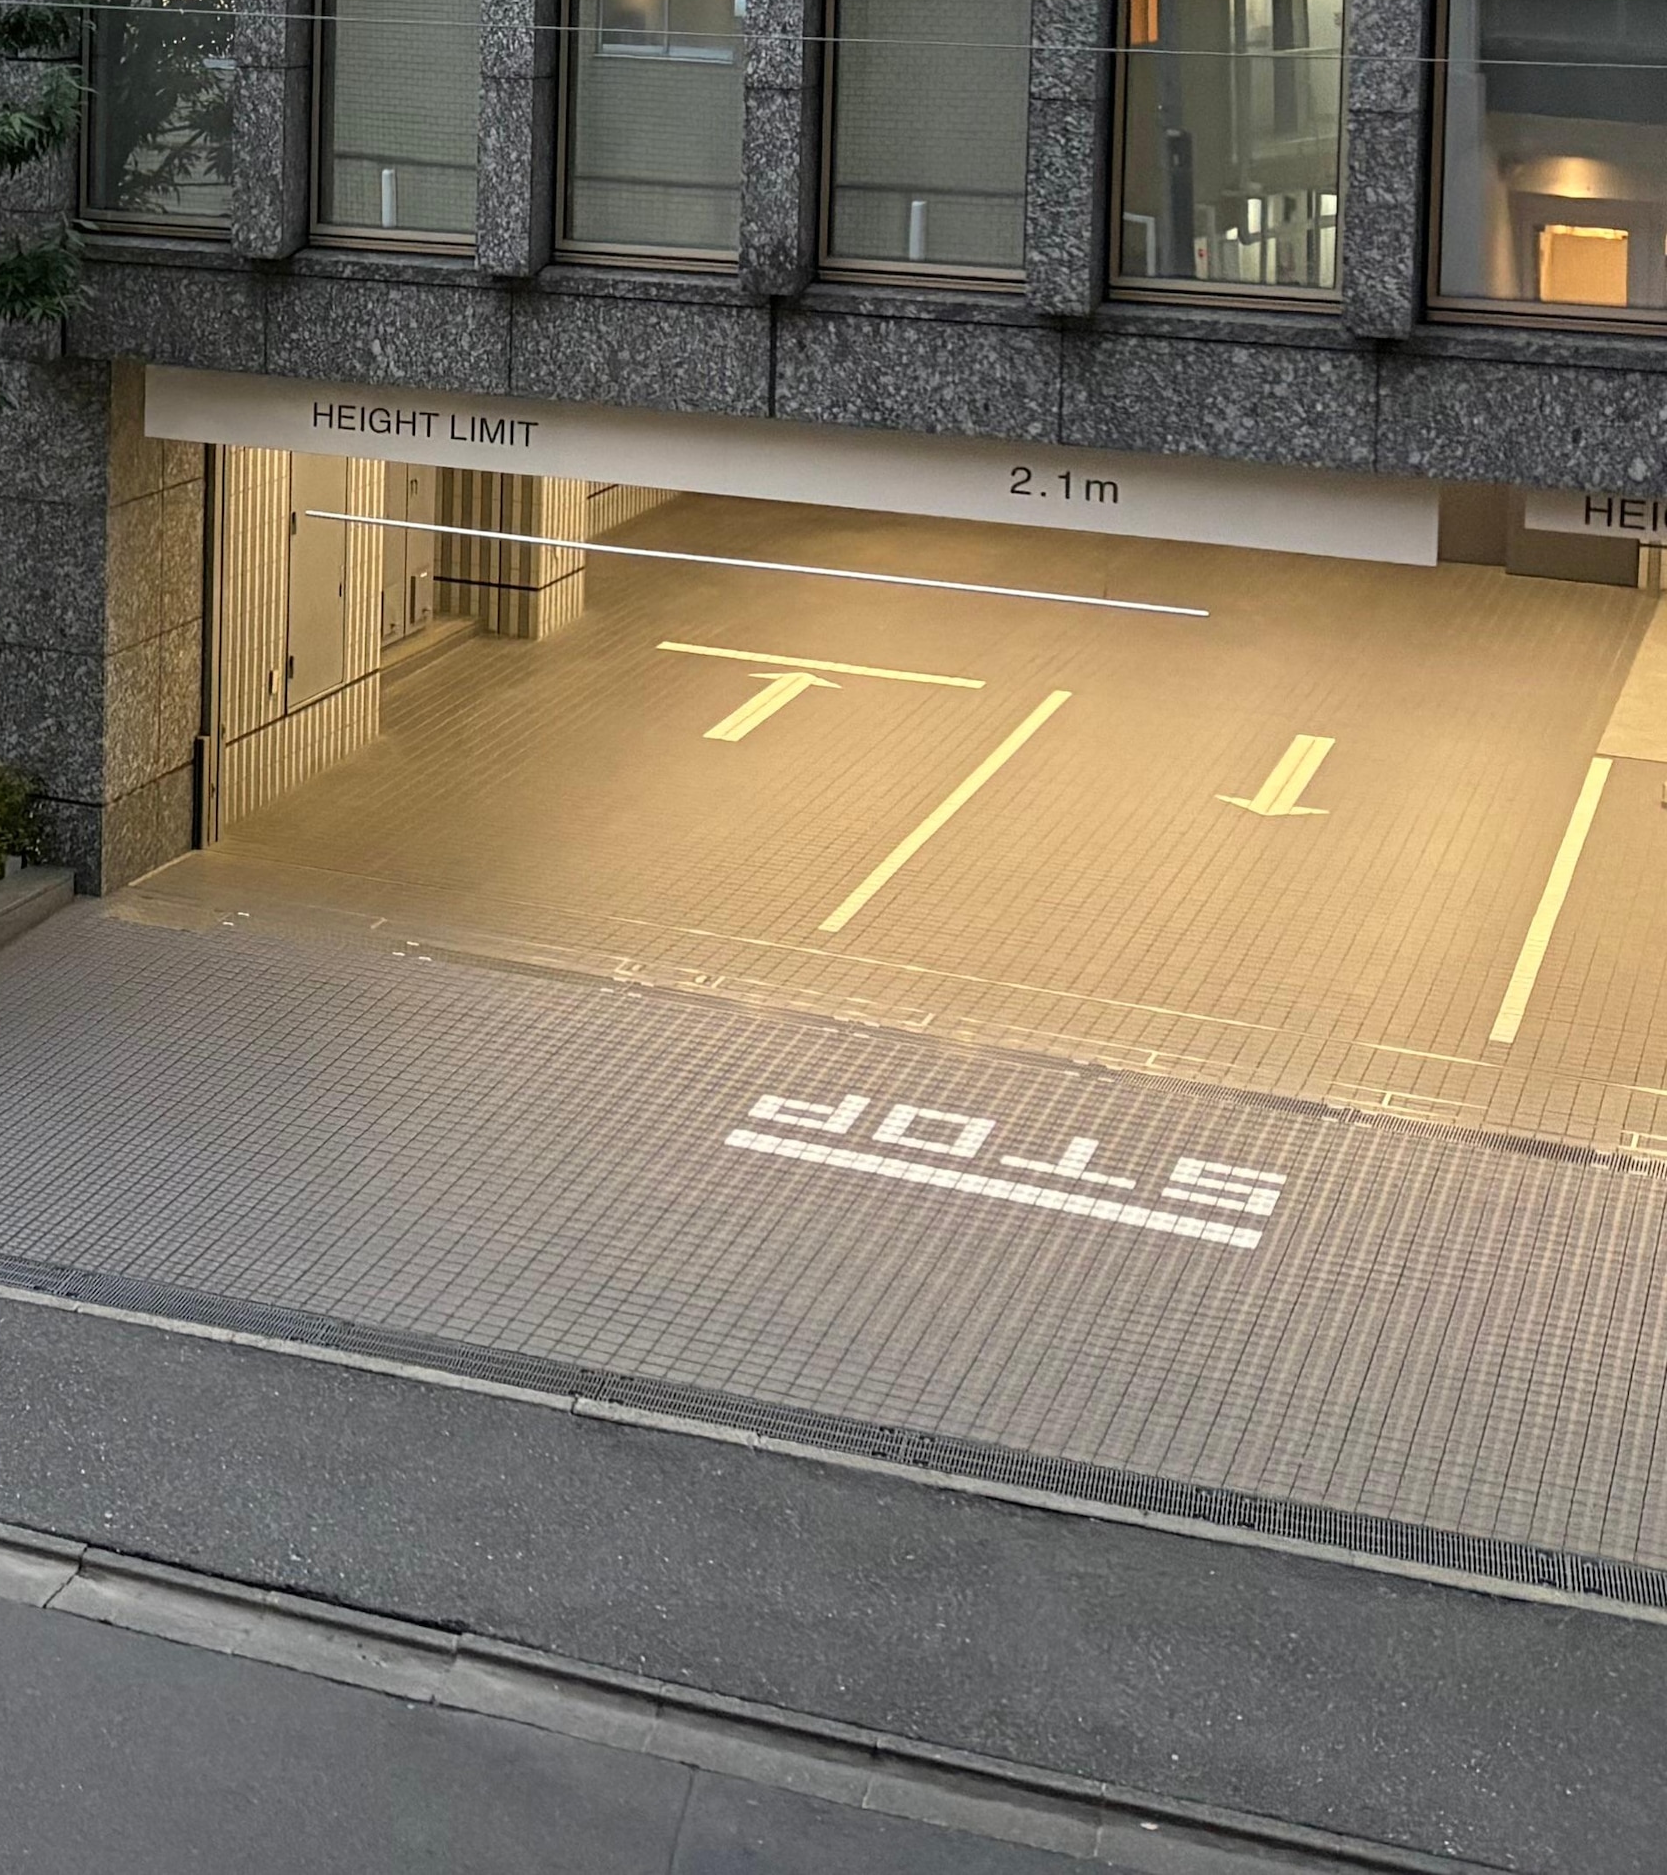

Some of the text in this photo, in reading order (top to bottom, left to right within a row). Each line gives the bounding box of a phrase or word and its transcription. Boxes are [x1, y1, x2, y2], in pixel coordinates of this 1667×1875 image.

[312, 401, 539, 448] HEIGHT LIMIT
[1009, 465, 1120, 505] 2.1m
[1584, 495, 1667, 532] HEI
[747, 1093, 1288, 1217] STOP
